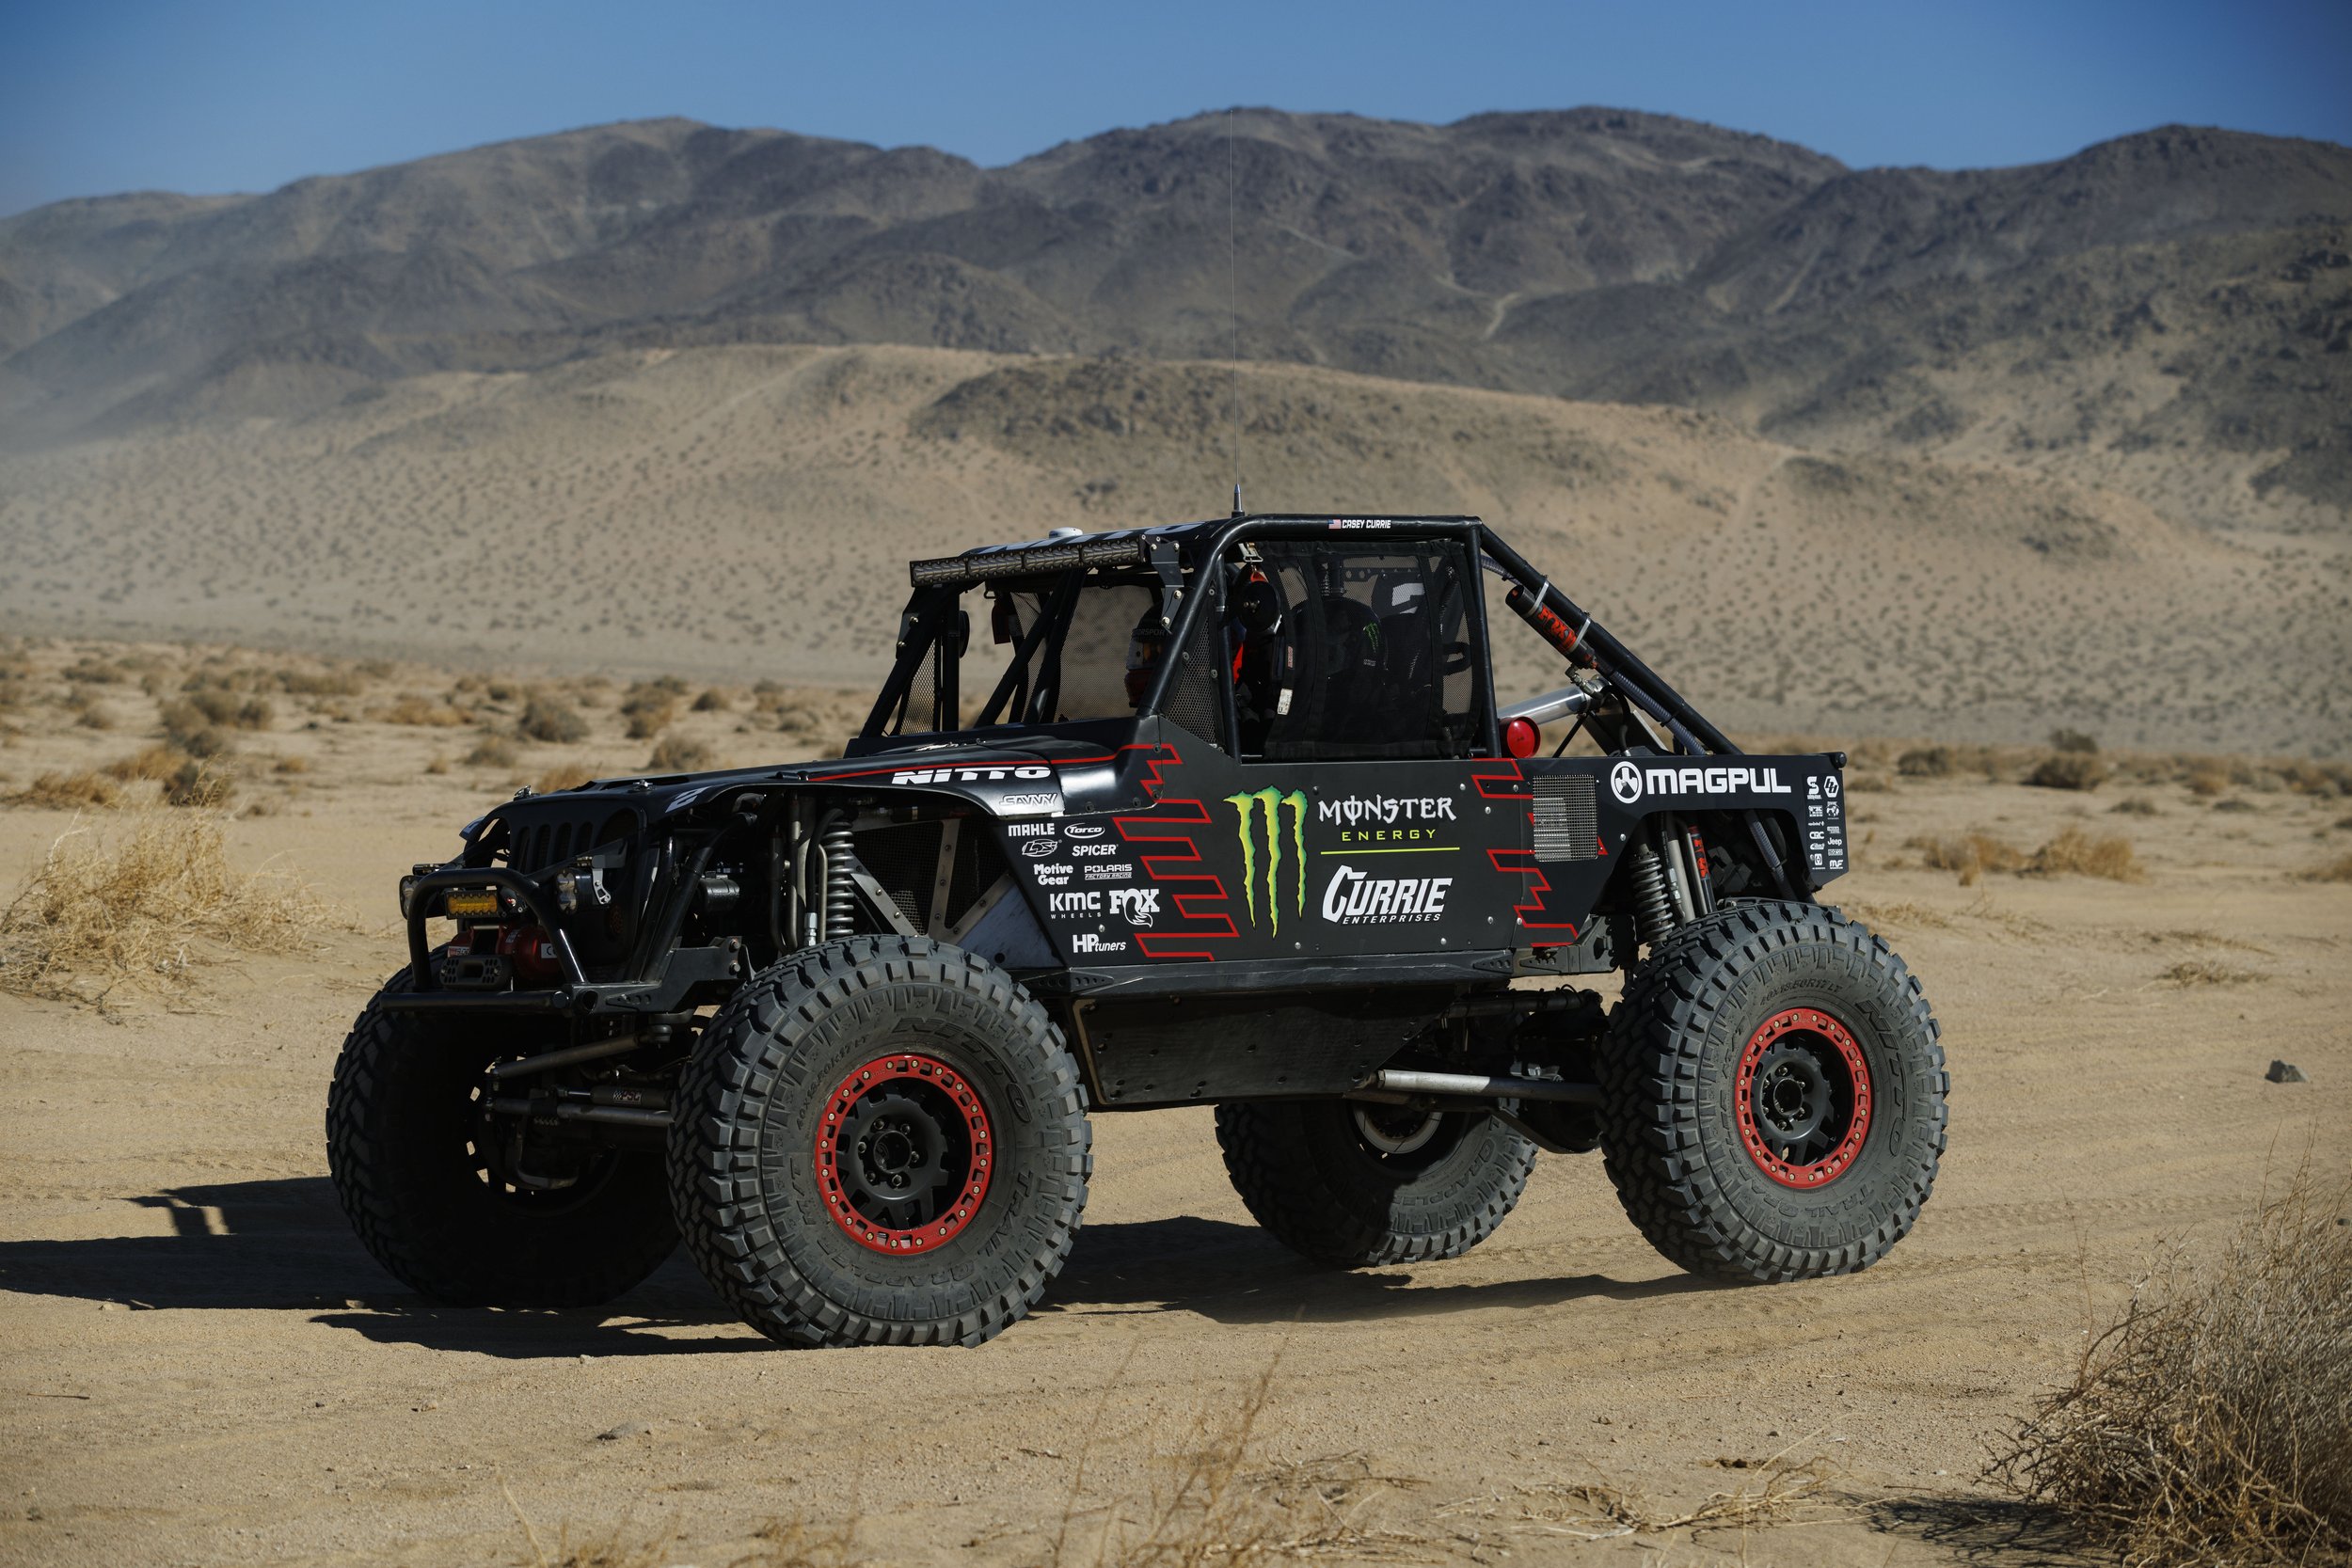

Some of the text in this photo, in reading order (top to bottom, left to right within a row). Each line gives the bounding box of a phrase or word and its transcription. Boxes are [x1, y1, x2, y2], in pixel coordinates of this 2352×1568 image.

[1342, 519, 1391, 529] CASEY CURRIE
[892, 766, 1051, 785] NITTO
[1645, 768, 1792, 795] MAGPUL
[1318, 794, 1457, 826] MONSTER
[1008, 823, 1056, 837] MAHLE
[1067, 825, 1103, 835] Torco
[1342, 829, 1438, 842] ENERGY
[1827, 837, 1842, 846] Jeep
[1072, 844, 1117, 856] SPICER
[1033, 863, 1073, 875] Motive
[1084, 863, 1133, 873] POLARIS
[1038, 875, 1070, 885] Gear
[1322, 864, 1454, 923] CURRIE
[1049, 892, 1102, 911] KMC
[1108, 888, 1160, 922] FOX
[1343, 913, 1441, 925] ENTERPRISES
[892, 1016, 1033, 1123] NITTO
[1855, 999, 1908, 1157] NITTO
